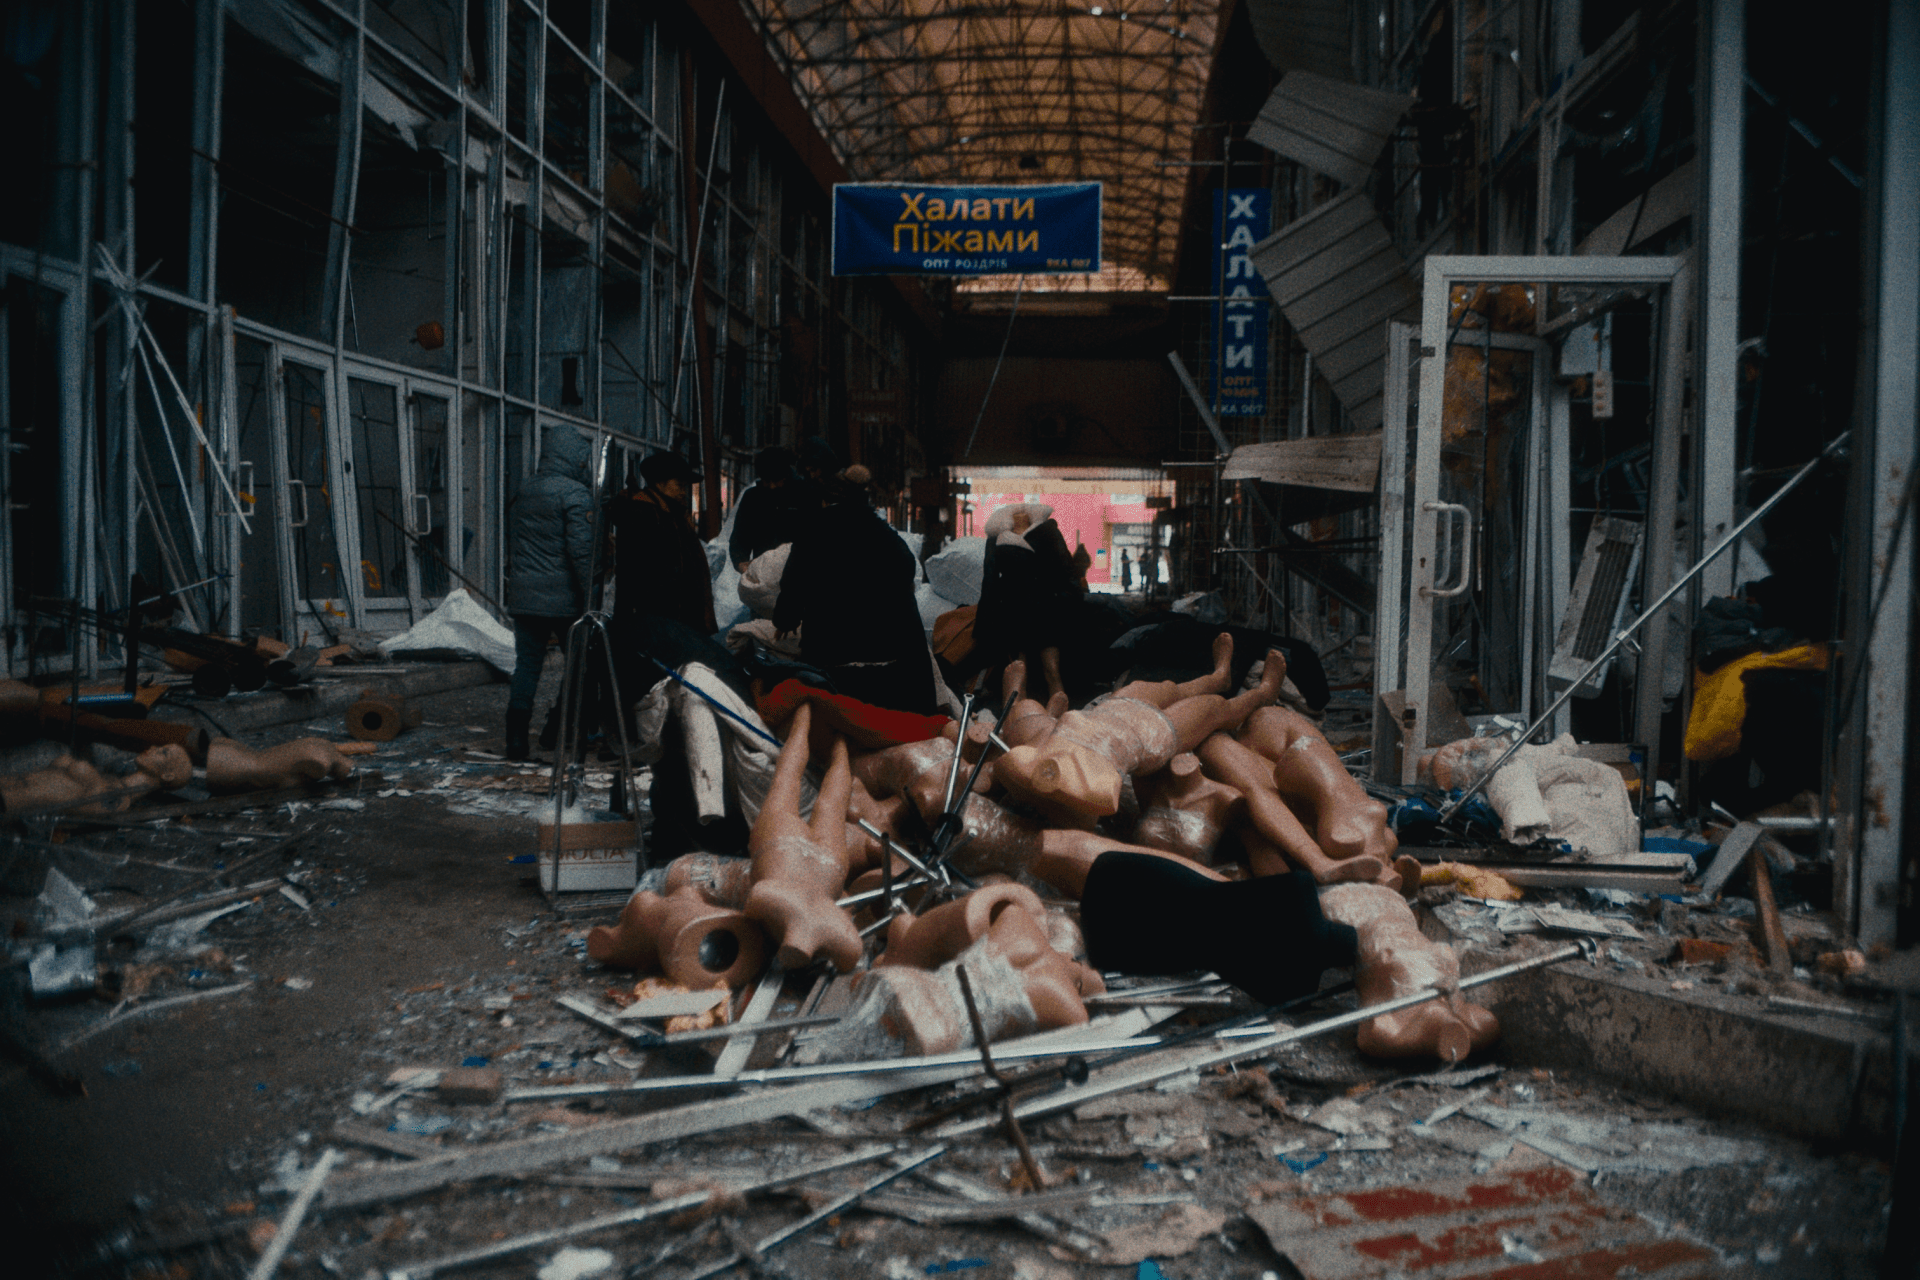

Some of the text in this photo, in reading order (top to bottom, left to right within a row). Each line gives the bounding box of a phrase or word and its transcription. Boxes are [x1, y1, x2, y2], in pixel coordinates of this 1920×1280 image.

[898, 192, 1035, 221] Халати
[893, 222, 1039, 253] Піжами
[922, 258, 950, 269] ОПТ
[1226, 194, 1257, 368] ХАЛАТИ
